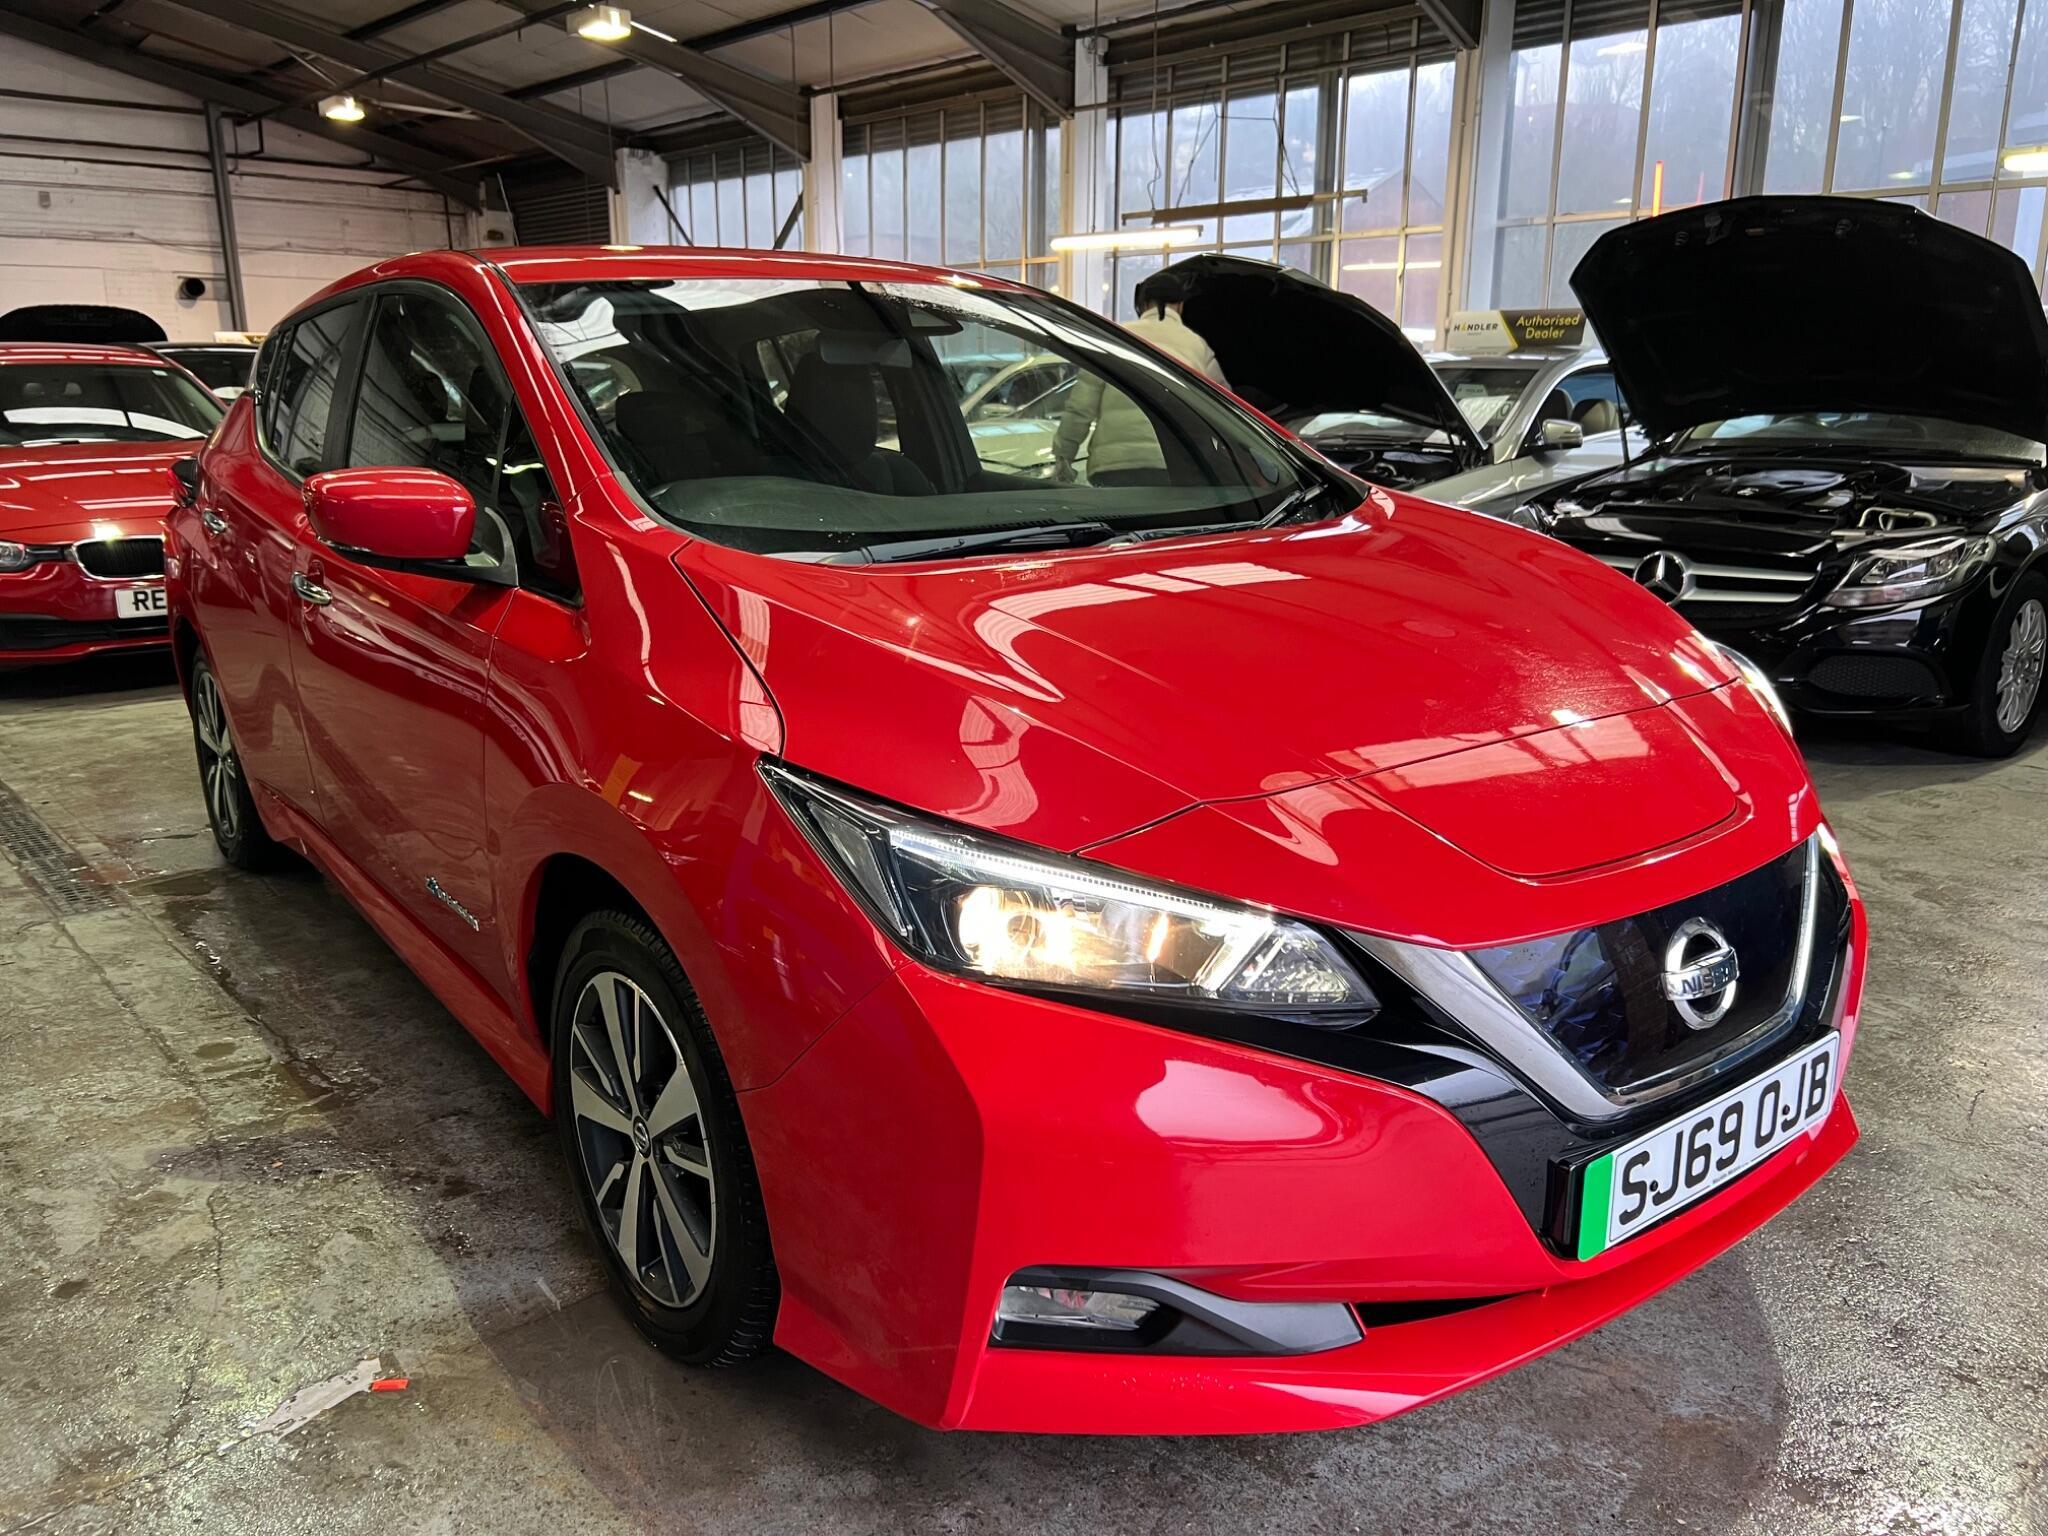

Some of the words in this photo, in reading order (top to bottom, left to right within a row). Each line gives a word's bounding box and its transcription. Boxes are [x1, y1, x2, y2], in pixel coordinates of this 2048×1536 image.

[1516, 314, 1580, 327] Authorised
[1525, 327, 1566, 339] Dealer
[1618, 1100, 1744, 1226] SJ69
[1755, 1050, 1830, 1149] OJB
